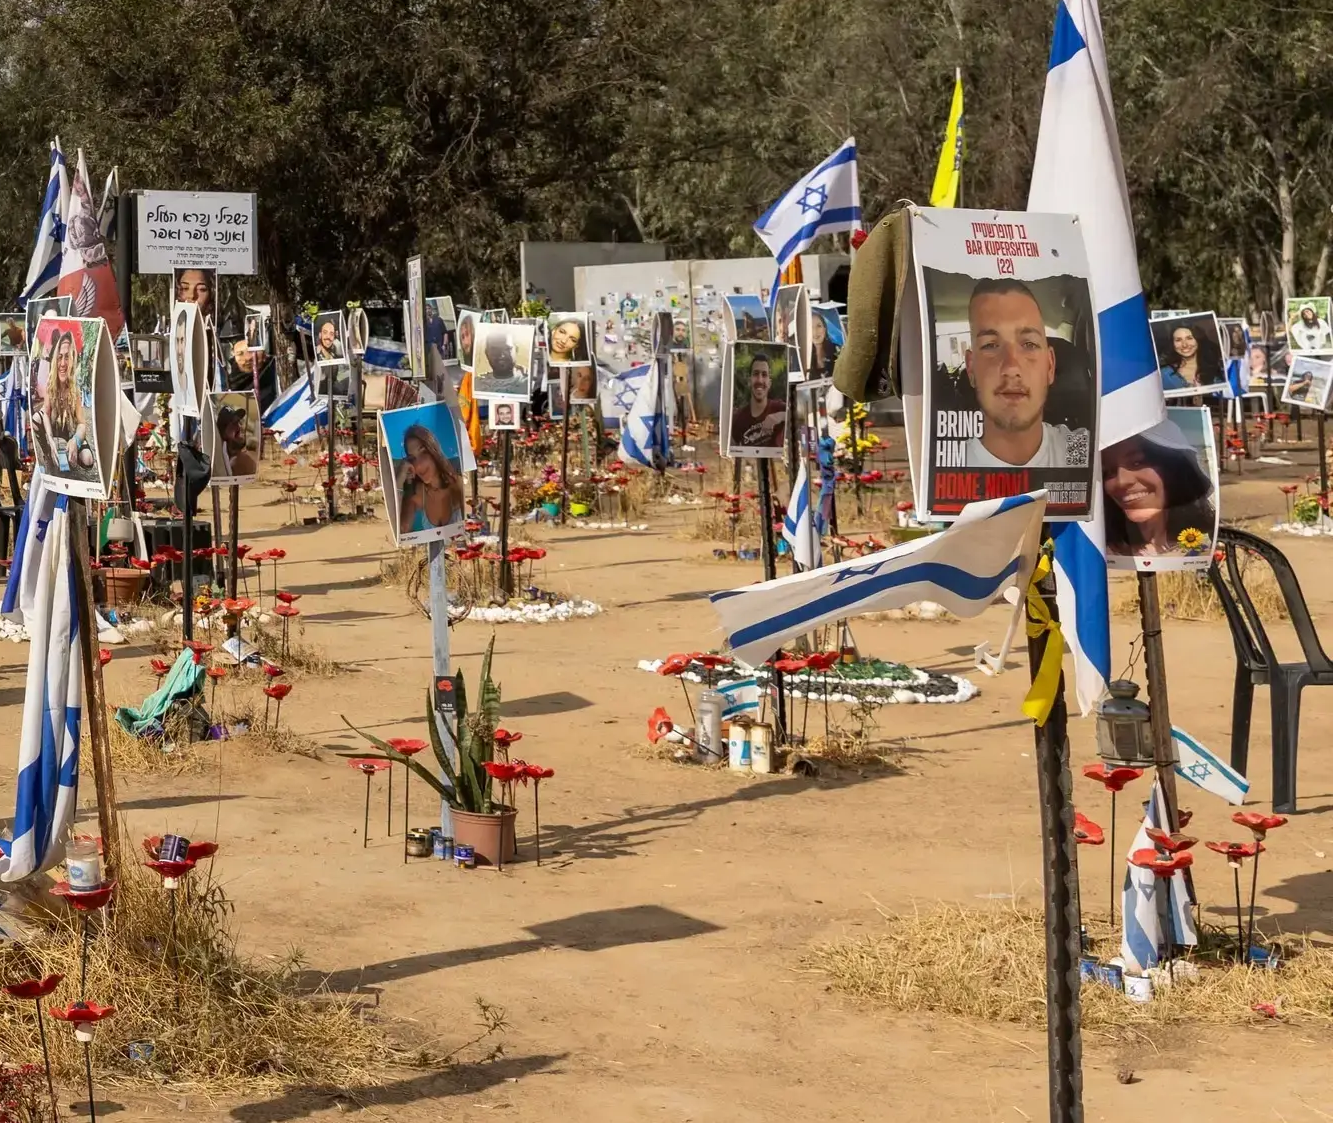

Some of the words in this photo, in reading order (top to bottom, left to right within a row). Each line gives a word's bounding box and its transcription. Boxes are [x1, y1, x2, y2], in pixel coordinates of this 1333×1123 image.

[146, 204, 178, 223] העולם
[182, 212, 211, 227] נברא
[215, 206, 248, 226] בשבילי
[149, 228, 181, 240] ואפר
[184, 228, 210, 241] עפר
[213, 229, 245, 245] ואנוכי
[971, 222, 1013, 240] קופרשטיין
[1015, 224, 1027, 239] בר
[965, 239, 984, 255] BAR
[984, 240, 1040, 257] KUPERSHTEIN
[997, 257, 1015, 275] (22)
[936, 410, 983, 438] BRING
[935, 440, 966, 467] HIM
[935, 473, 980, 500] HOME
[985, 469, 1029, 499] NOW!
[1069, 491, 1087, 504] FORUM
